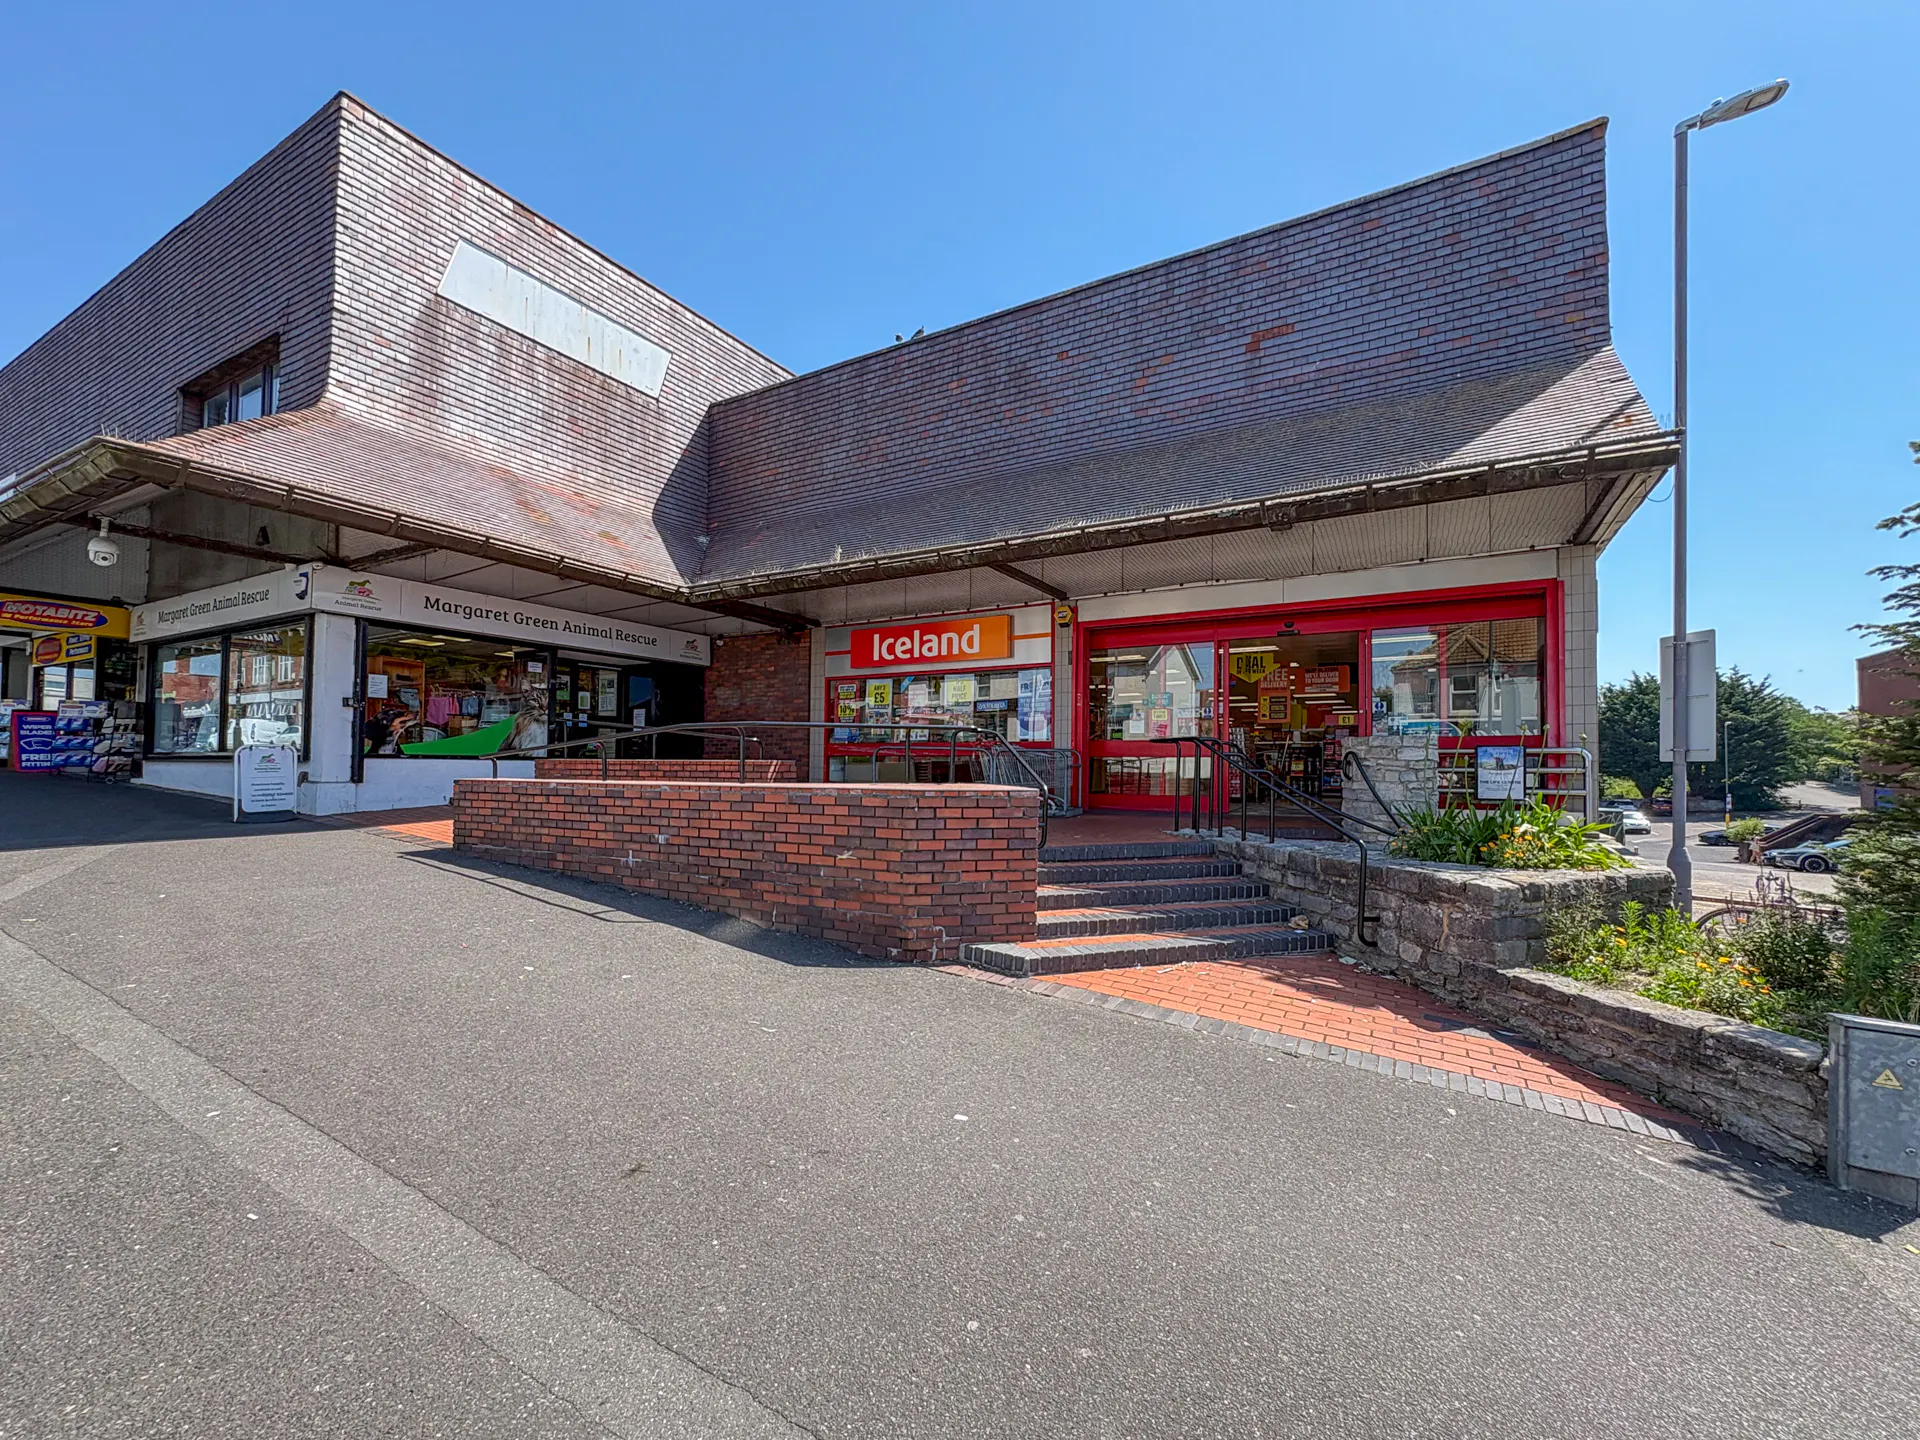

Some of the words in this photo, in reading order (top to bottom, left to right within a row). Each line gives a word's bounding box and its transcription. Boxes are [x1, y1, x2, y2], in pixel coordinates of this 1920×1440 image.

[3, 602, 98, 621] MOTABITZ
[158, 606, 189, 624] Margaret
[190, 603, 211, 617] Green
[212, 592, 241, 611] Animal
[241, 588, 270, 605] Rescue
[334, 599, 359, 608] Animal
[360, 603, 382, 612] Rescue
[14, 614, 69, 624] Performance
[423, 595, 509, 622] Margaret
[513, 612, 559, 631] Green
[562, 620, 612, 640] Animal
[615, 628, 658, 647] Rescue
[873, 623, 980, 661] Iceland
[874, 692, 885, 703] £5
[952, 692, 968, 700] PRICE
[1342, 716, 1350, 724] £1
